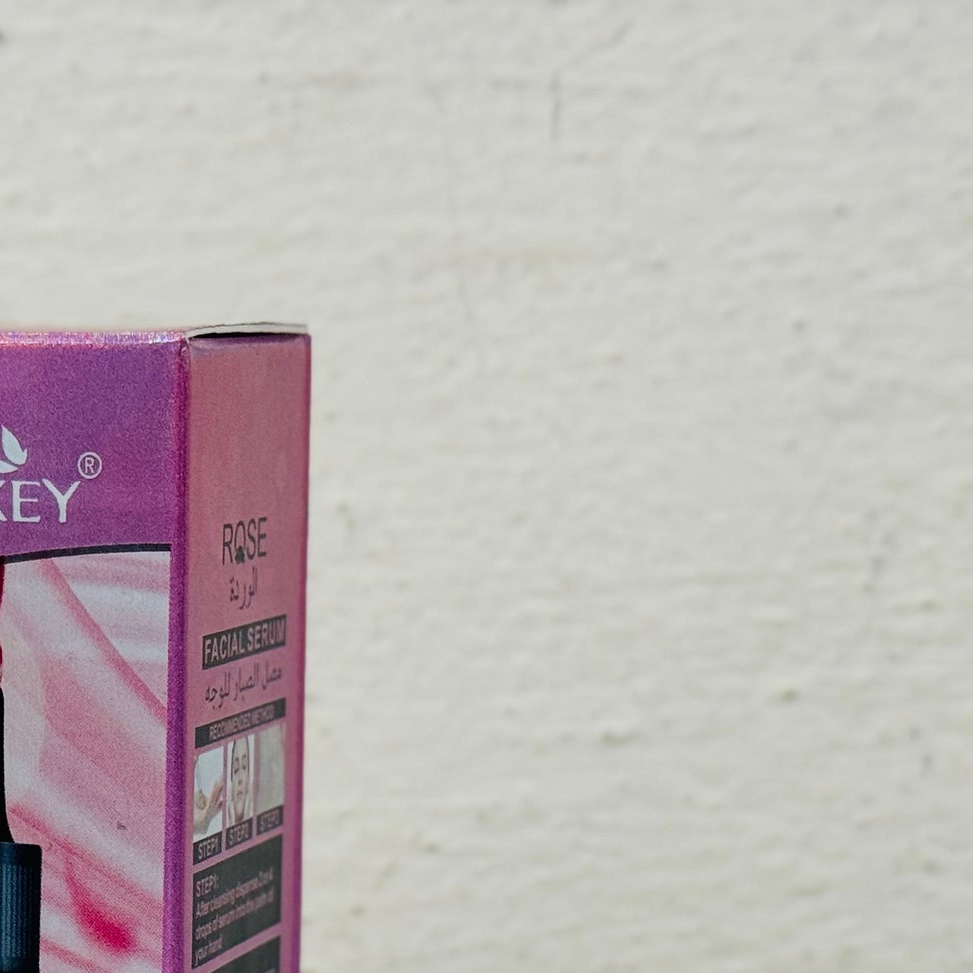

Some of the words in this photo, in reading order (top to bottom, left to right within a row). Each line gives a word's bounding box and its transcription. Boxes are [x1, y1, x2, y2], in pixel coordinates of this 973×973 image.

[222, 517, 267, 565] ROSE
[204, 630, 245, 664] FACIAL
[247, 618, 284, 651] SERUM
